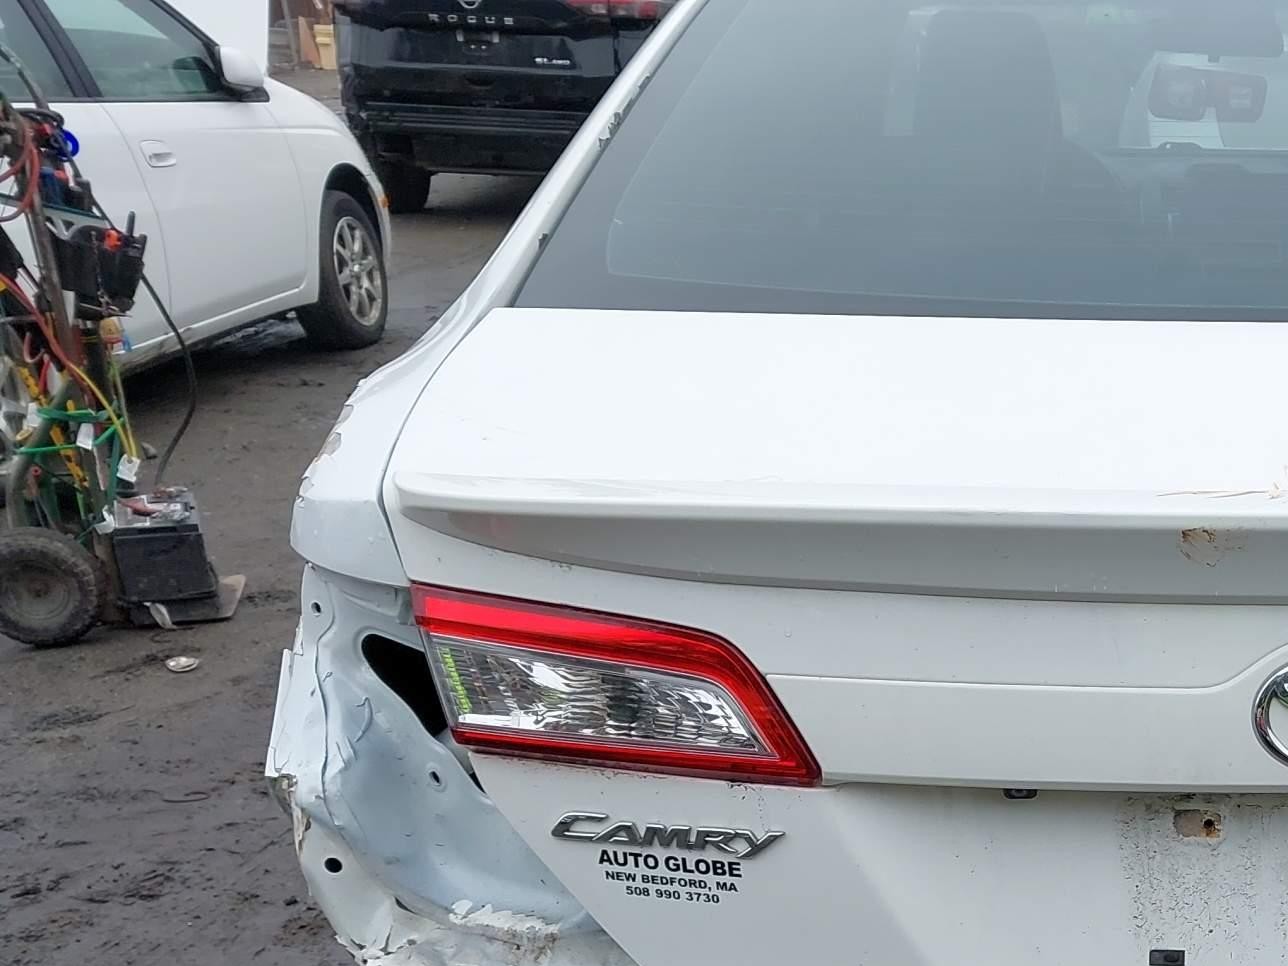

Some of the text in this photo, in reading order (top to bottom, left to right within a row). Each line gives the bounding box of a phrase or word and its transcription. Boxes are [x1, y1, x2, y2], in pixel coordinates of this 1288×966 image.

[428, 13, 514, 25] ROGUE
[551, 810, 786, 859] CAMRY
[598, 849, 743, 878] AUTO GLOBE
[605, 870, 739, 892] NEW BEDFORD, MA
[625, 885, 720, 904] 508 990 3730
